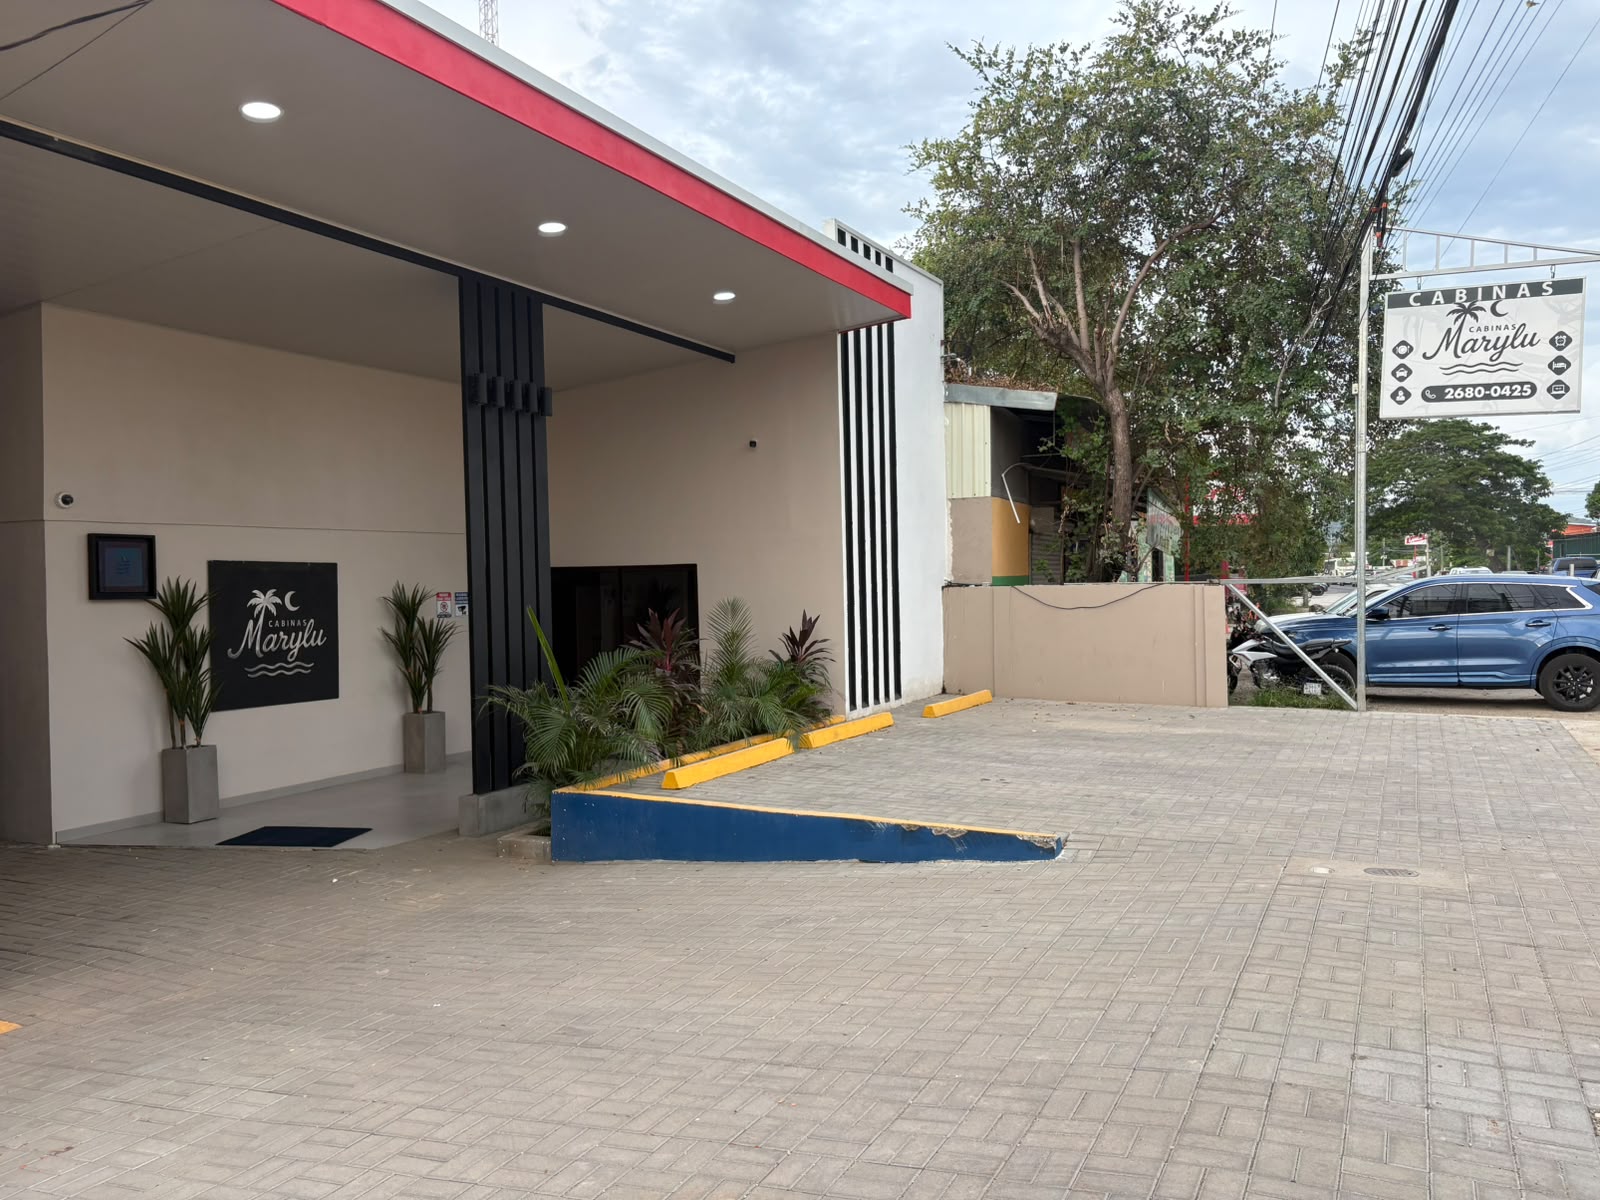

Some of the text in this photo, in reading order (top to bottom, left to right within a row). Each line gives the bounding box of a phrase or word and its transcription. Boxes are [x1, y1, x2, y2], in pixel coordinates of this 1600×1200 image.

[1408, 281, 1554, 307] CABINAS
[1468, 323, 1517, 333] CABINAS
[1422, 322, 1541, 362] Marylu
[1444, 384, 1532, 400] 2680-0425
[268, 619, 307, 628] CABINAS
[226, 618, 327, 662] Marylu
